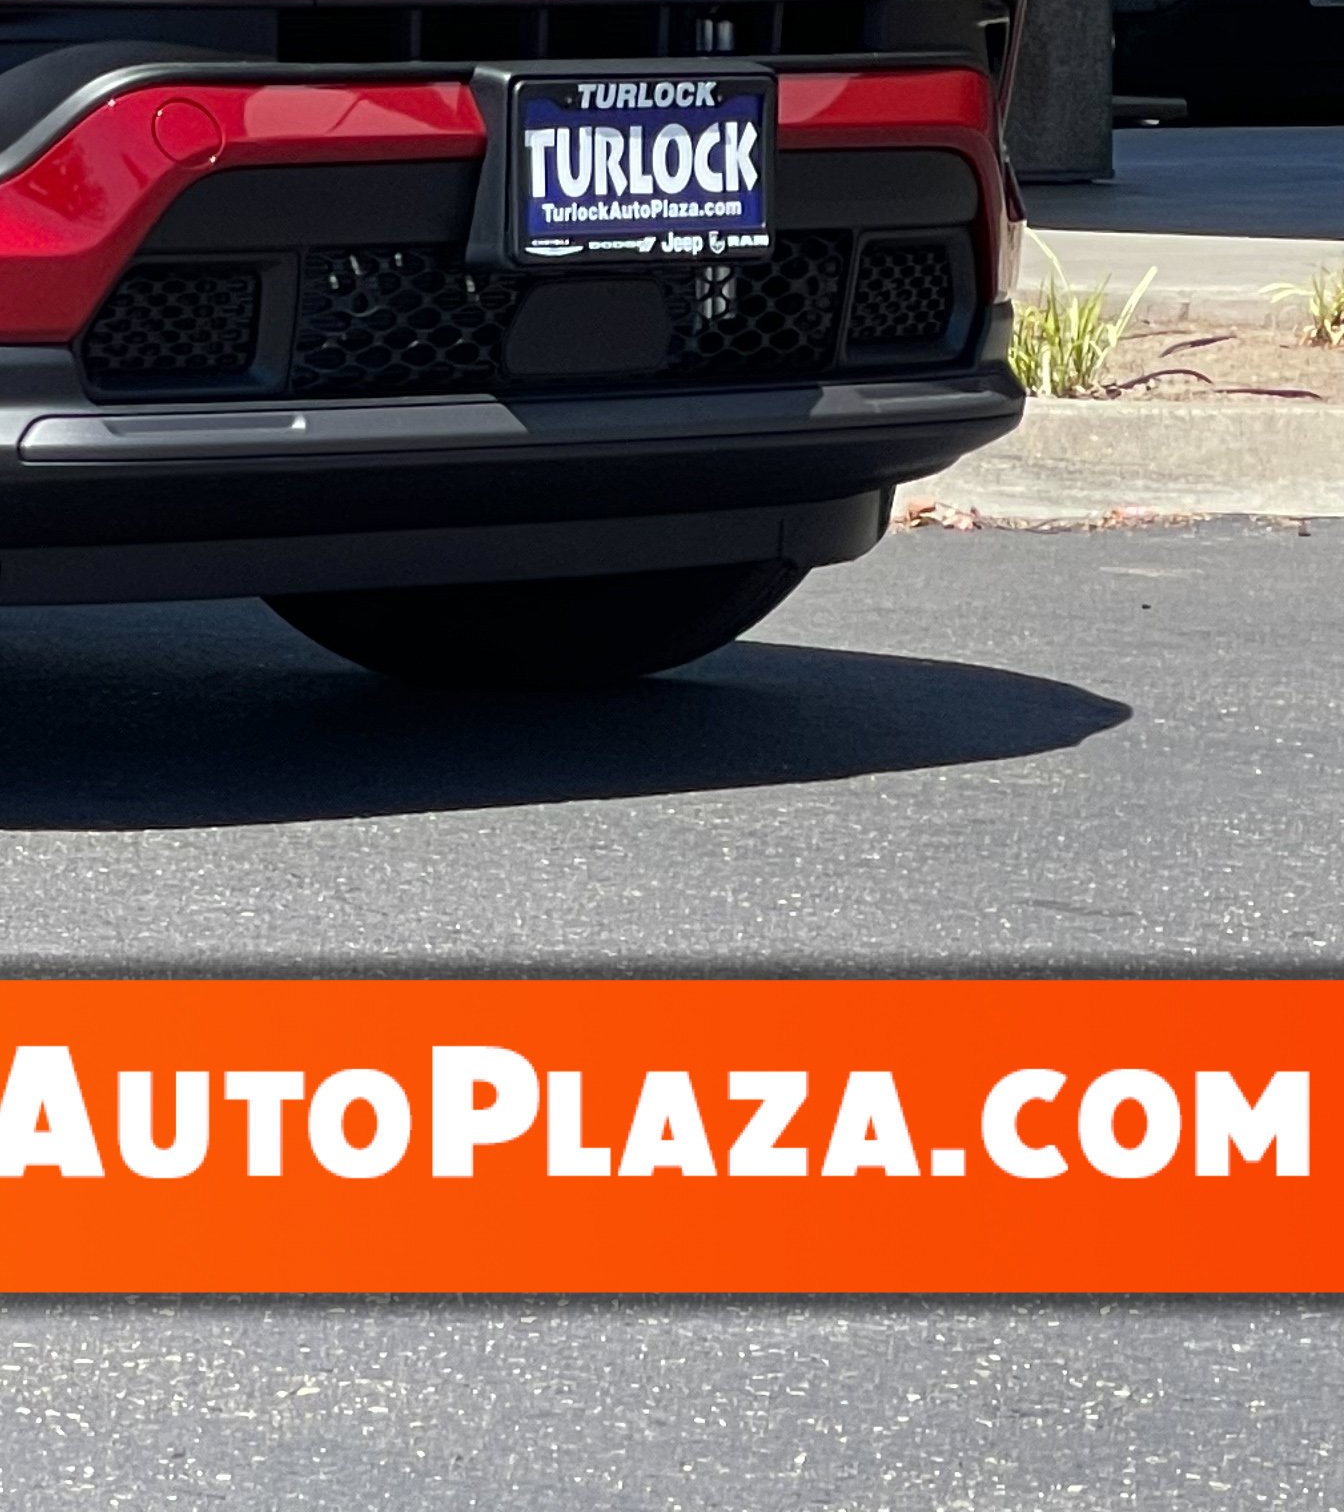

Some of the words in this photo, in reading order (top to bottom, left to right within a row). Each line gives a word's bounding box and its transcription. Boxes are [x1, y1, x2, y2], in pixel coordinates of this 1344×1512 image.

[577, 81, 717, 109] TURLOCK
[524, 121, 759, 198] TURLOCK
[542, 198, 742, 224] TurlockAutoPlaza.com
[661, 231, 704, 255] Jeep
